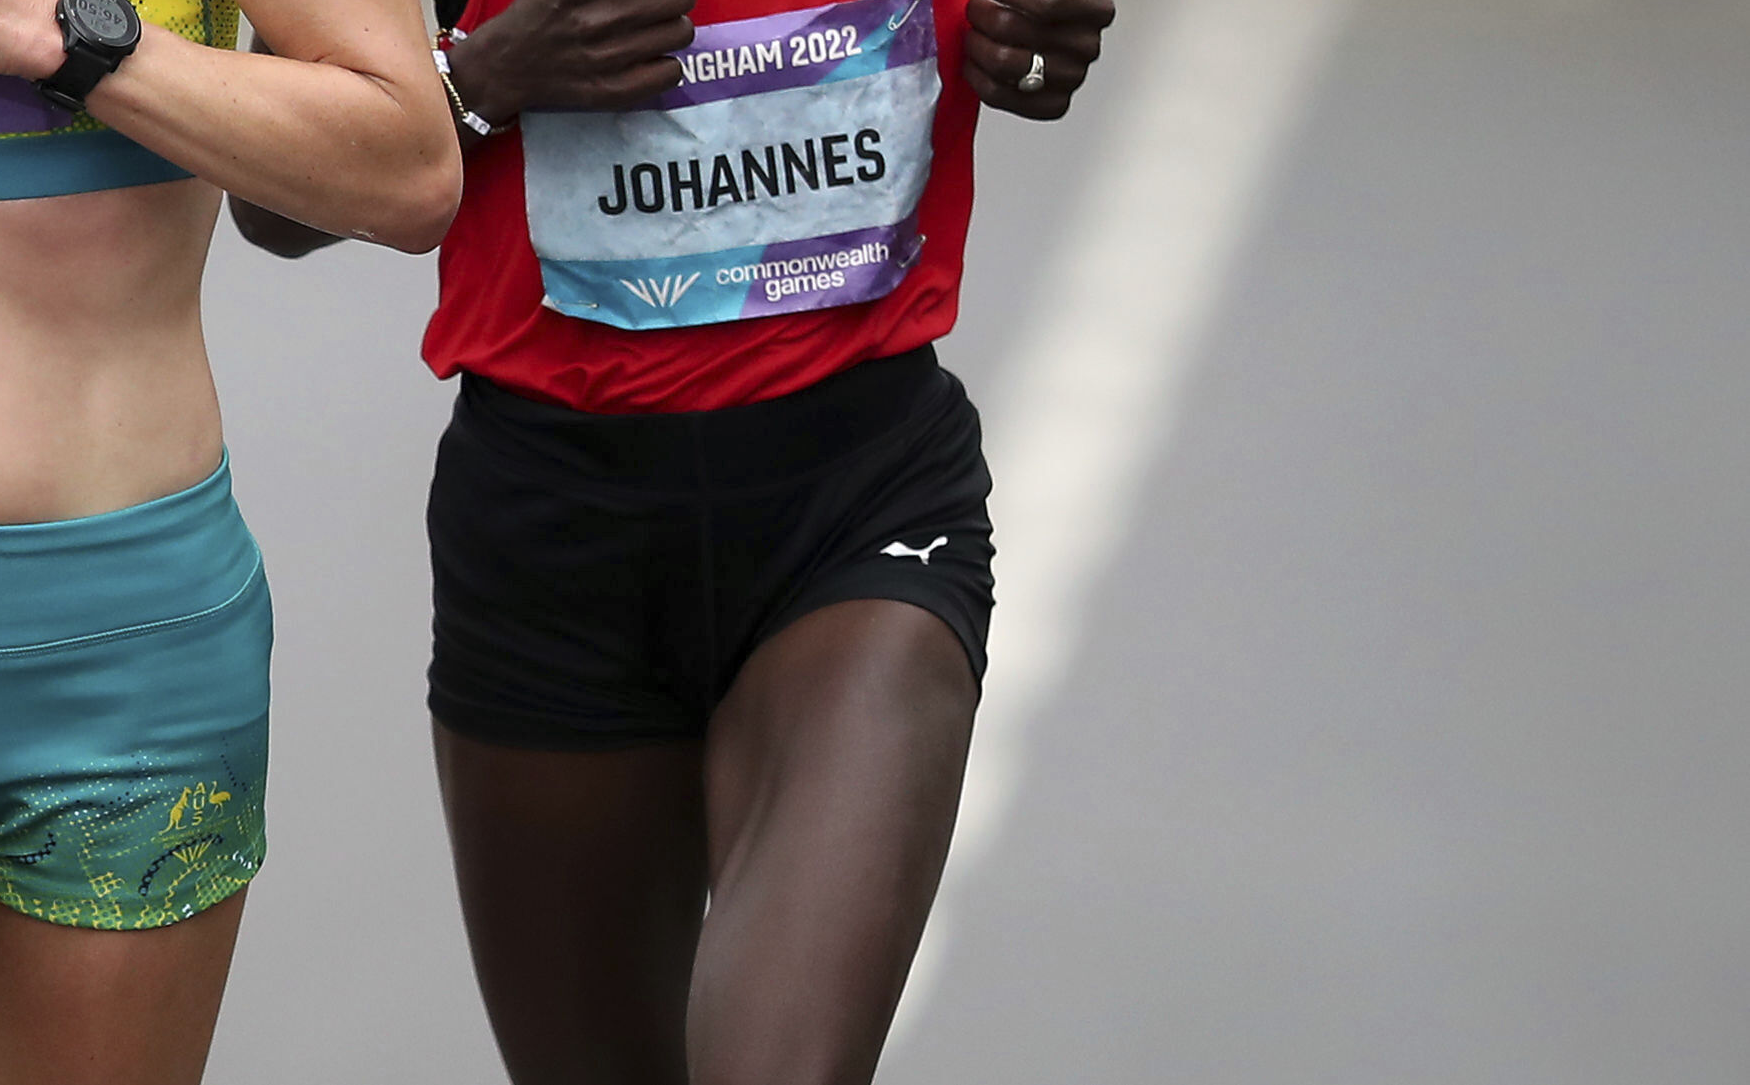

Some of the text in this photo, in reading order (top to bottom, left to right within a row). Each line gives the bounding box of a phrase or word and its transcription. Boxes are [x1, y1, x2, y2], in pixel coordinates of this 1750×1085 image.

[677, 24, 863, 87] NGHAM 2022
[598, 128, 886, 216] JOHANNES
[716, 241, 890, 285] commonwealth
[765, 271, 846, 302] games
